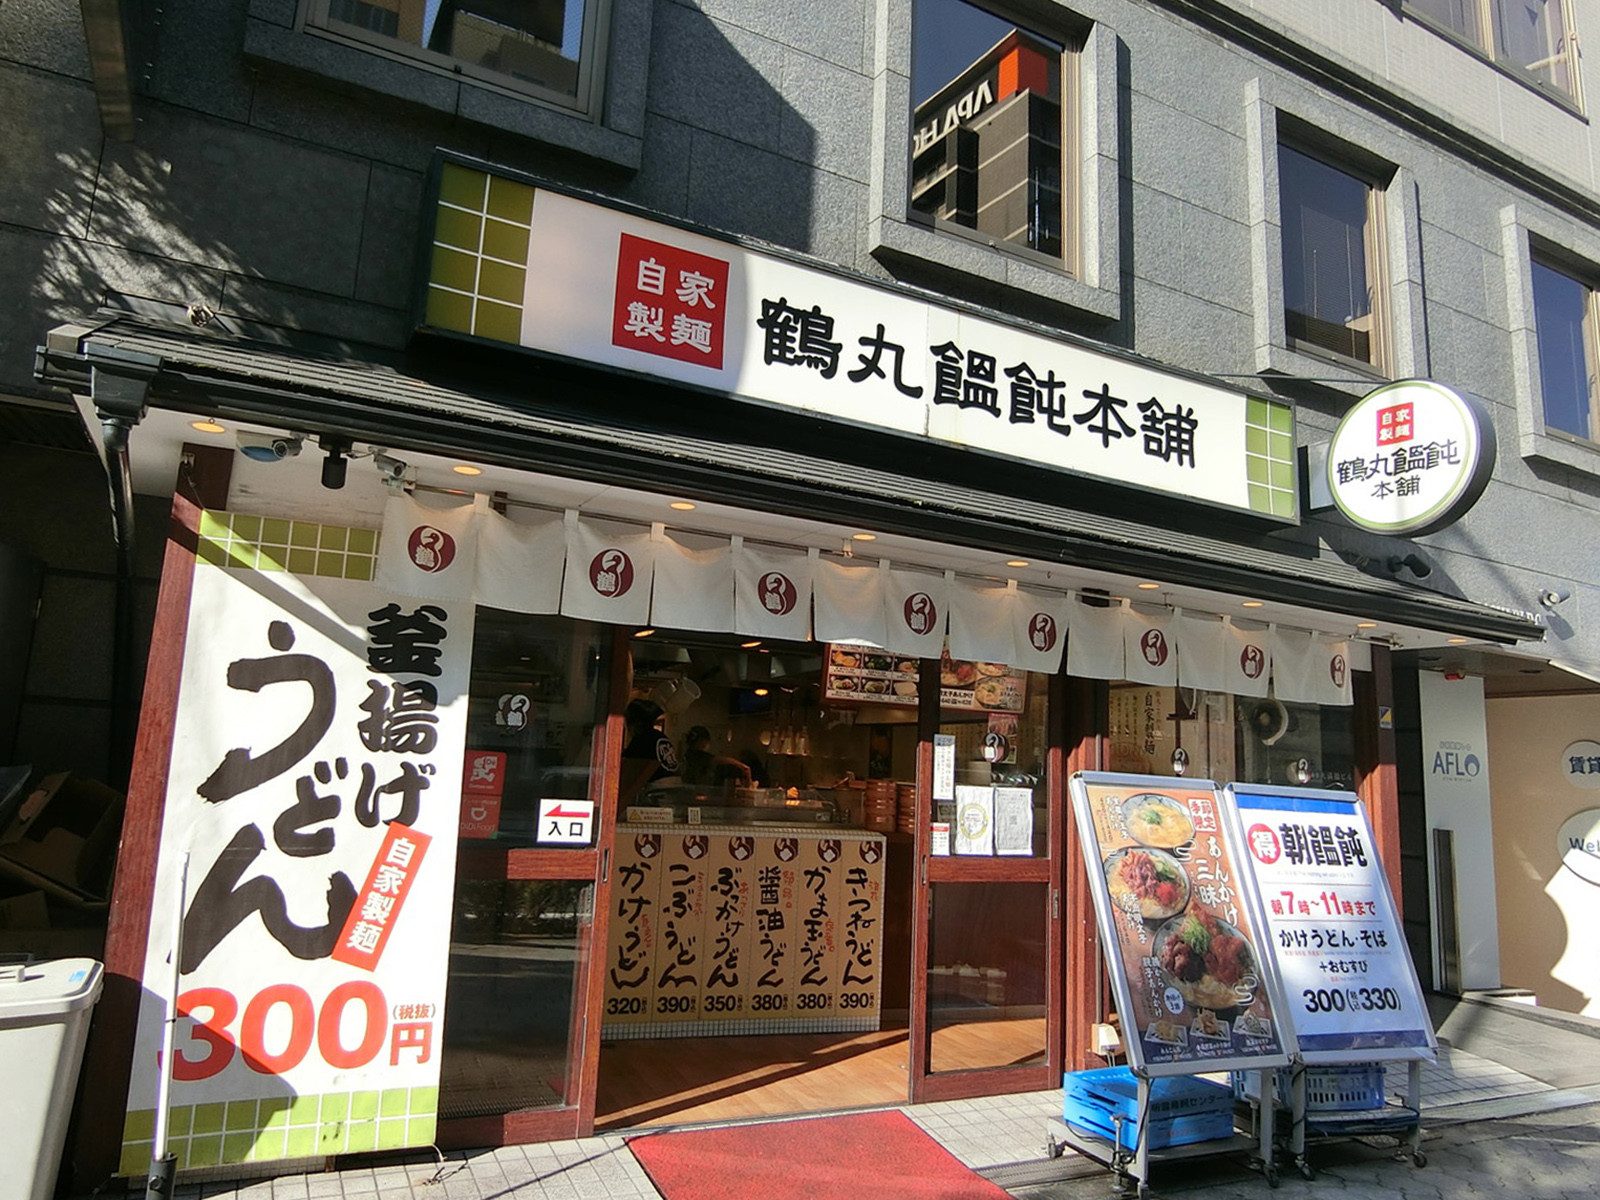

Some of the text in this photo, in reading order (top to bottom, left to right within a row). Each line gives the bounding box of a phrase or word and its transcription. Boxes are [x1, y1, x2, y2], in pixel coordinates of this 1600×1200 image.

[637, 257, 716, 309] 自家
[624, 301, 713, 354] 製麺
[757, 297, 1198, 469] 鶴丸饂飩本舗
[1378, 424, 1410, 442] 製麺
[1381, 408, 1410, 426] 自家
[1336, 438, 1461, 485] 鶴丸饂飩
[1371, 474, 1421, 500] 本舗
[355, 602, 448, 829] 釜揚げ
[1432, 751, 1480, 778] AFLO
[167, 619, 360, 976] うどん
[547, 821, 584, 837] 入口
[1279, 822, 1368, 867] 朝饂飩
[346, 837, 417, 955] 自家製麺
[1195, 858, 1221, 909] 三味
[1207, 835, 1238, 928] あんかけ
[610, 862, 652, 990] かけうどん
[657, 863, 698, 989] こぶうどん
[706, 866, 745, 989] ぶっかけうどん
[756, 866, 785, 988] 醤油うどん
[800, 865, 831, 987] かま玉うどん
[842, 867, 877, 986] きつねうどん
[392, 1002, 437, 1020] (税抜)
[606, 997, 641, 1015] 320
[656, 995, 690, 1014] 390
[703, 994, 737, 1012] 350
[751, 994, 783, 1011] 380
[796, 993, 827, 1010] 380
[839, 992, 869, 1009] 390
